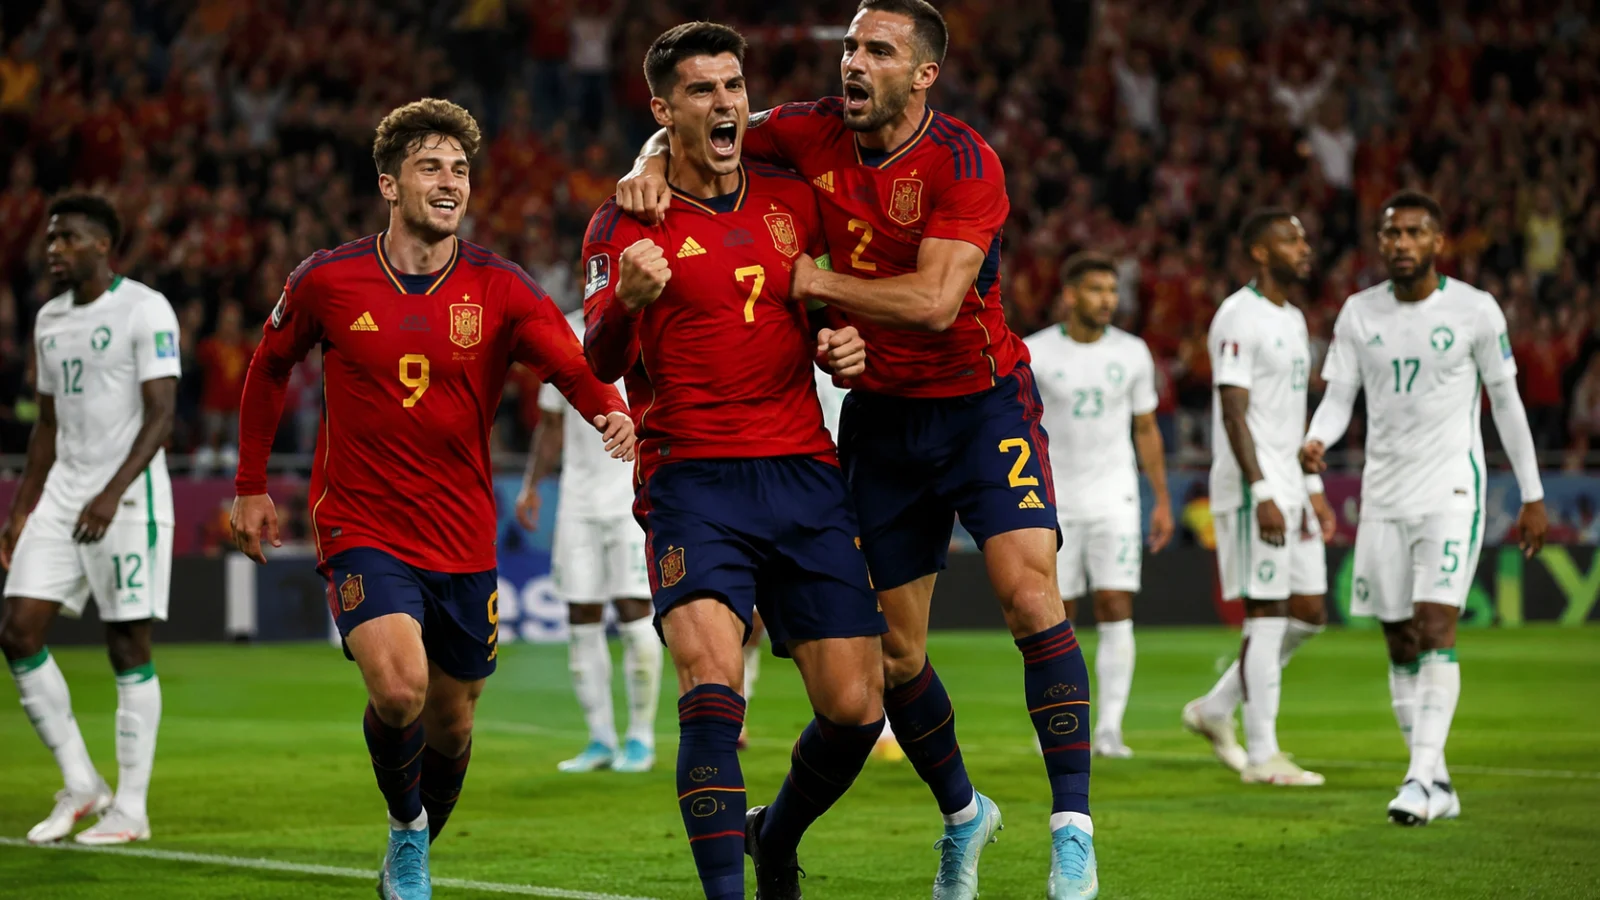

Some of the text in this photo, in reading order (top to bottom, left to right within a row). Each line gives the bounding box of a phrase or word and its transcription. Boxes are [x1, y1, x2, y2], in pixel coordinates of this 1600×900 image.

[848, 218, 876, 271] 2
[735, 265, 765, 323] 7
[61, 357, 83, 394] 12
[399, 354, 430, 407] 9
[1392, 358, 1420, 393] 17
[1072, 388, 1104, 418] 23
[999, 438, 1039, 488] 2
[112, 553, 143, 590] 12
[1440, 540, 1460, 573] 5
